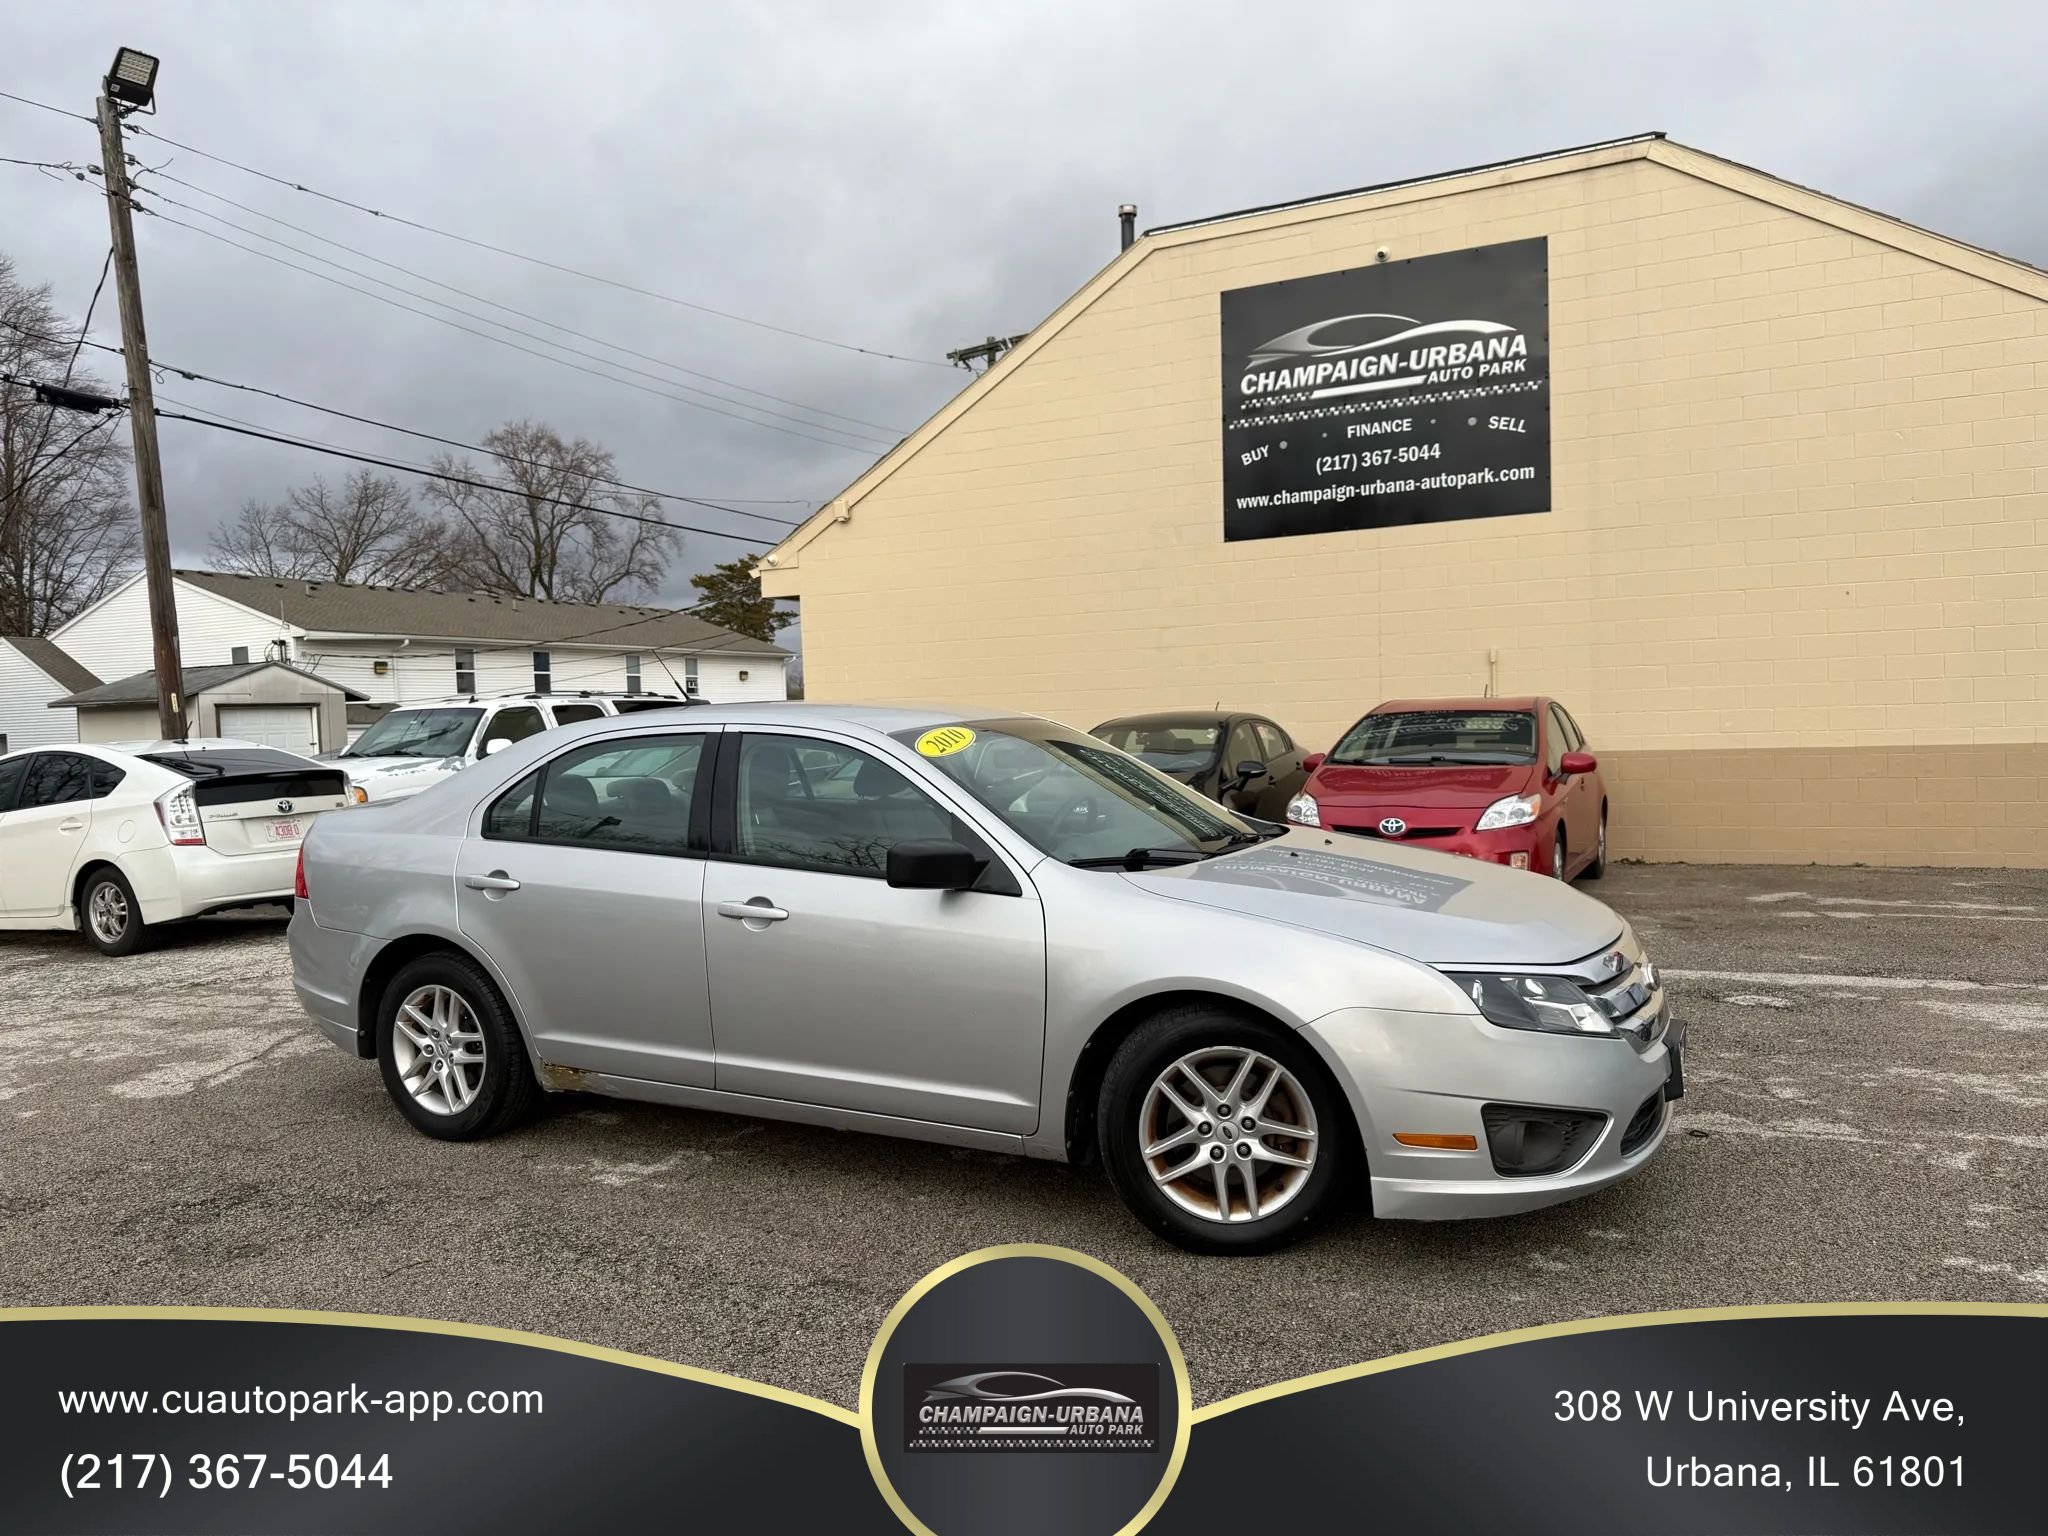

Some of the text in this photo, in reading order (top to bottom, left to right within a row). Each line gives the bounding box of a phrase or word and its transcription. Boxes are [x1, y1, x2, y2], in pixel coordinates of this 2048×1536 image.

[1240, 334, 1527, 395] CHAMPAIGN-URBANA
[1427, 358, 1527, 385] AUTO PARK
[1240, 415, 1527, 466] BUY FINANCE SELL
[1315, 443, 1441, 476] (217) 367-5044
[1236, 465, 1535, 510] www.champaign-urbana-autopark.com
[925, 729, 966, 753] 2010
